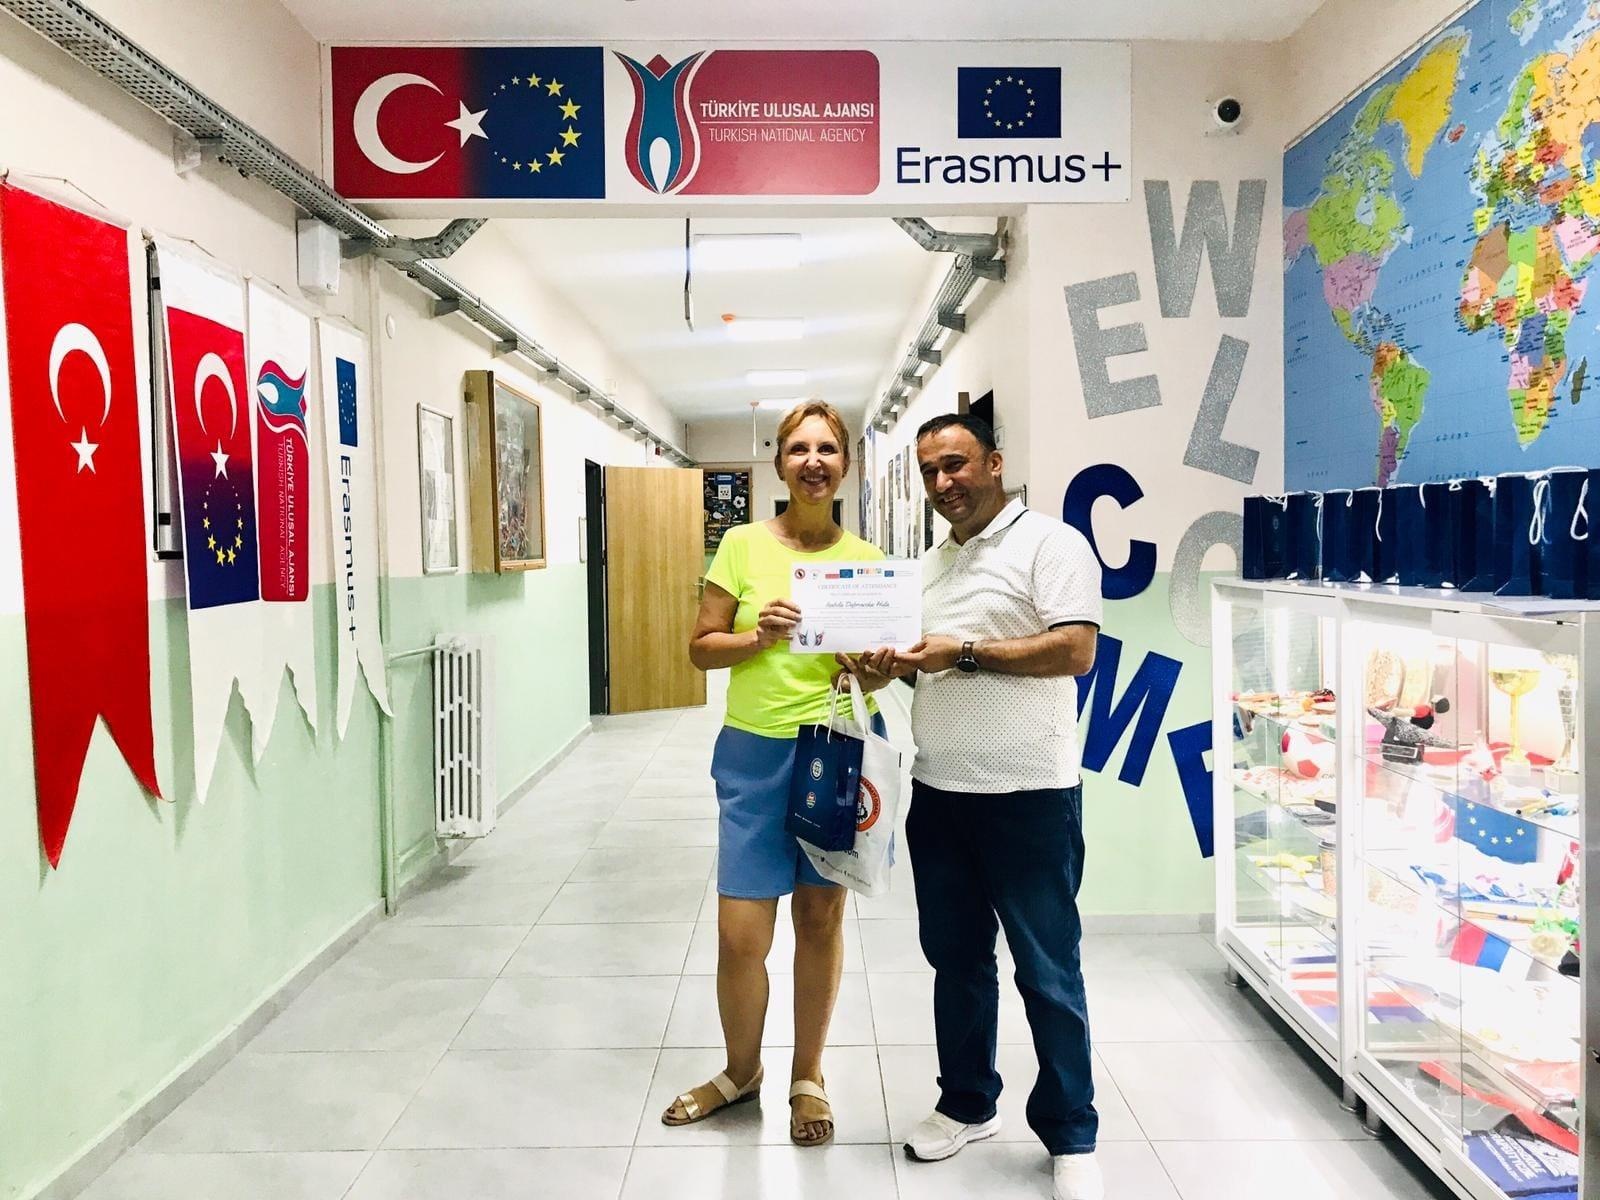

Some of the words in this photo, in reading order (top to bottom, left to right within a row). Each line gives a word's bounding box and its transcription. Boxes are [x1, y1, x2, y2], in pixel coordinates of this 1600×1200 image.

[700, 100, 760, 118] TÜRKİYE
[764, 103, 820, 118] ULUSAL
[823, 103, 874, 118] AJANSI
[709, 128, 757, 142] TURKISH
[761, 128, 816, 142] NATIONAL
[820, 128, 866, 142] AGENCY
[896, 147, 1122, 184] Erasmus+
[285, 437, 295, 492] TÜRKİYE
[287, 495, 295, 547] ULUSAL
[340, 455, 356, 641] Erasmus+
